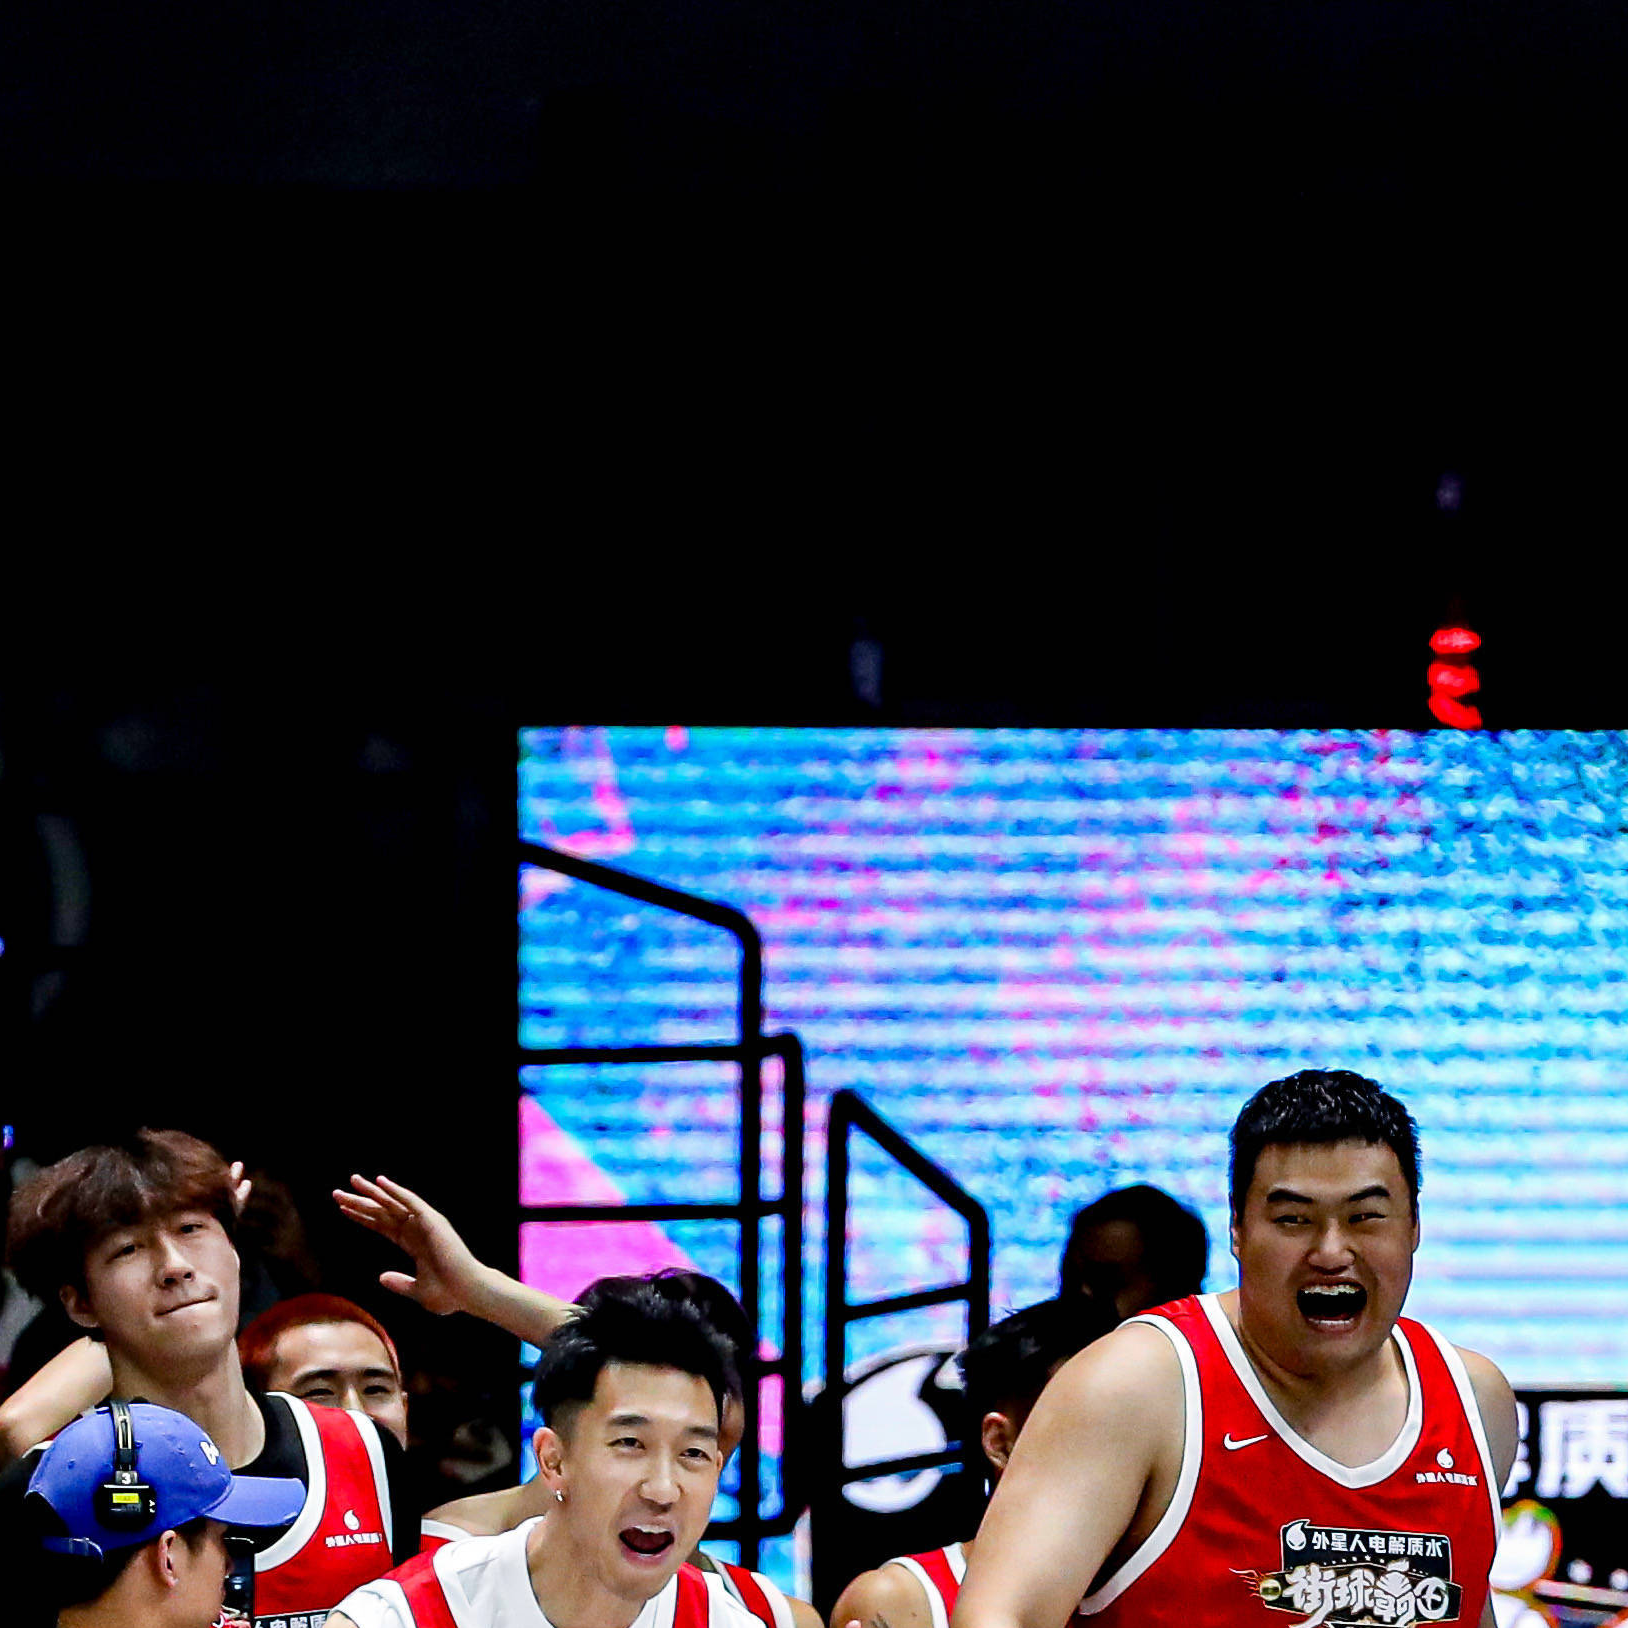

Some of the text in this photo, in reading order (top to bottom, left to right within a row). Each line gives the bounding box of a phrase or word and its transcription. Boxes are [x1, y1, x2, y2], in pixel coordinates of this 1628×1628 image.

[1311, 1531, 1443, 1558] 外星人电解质水
